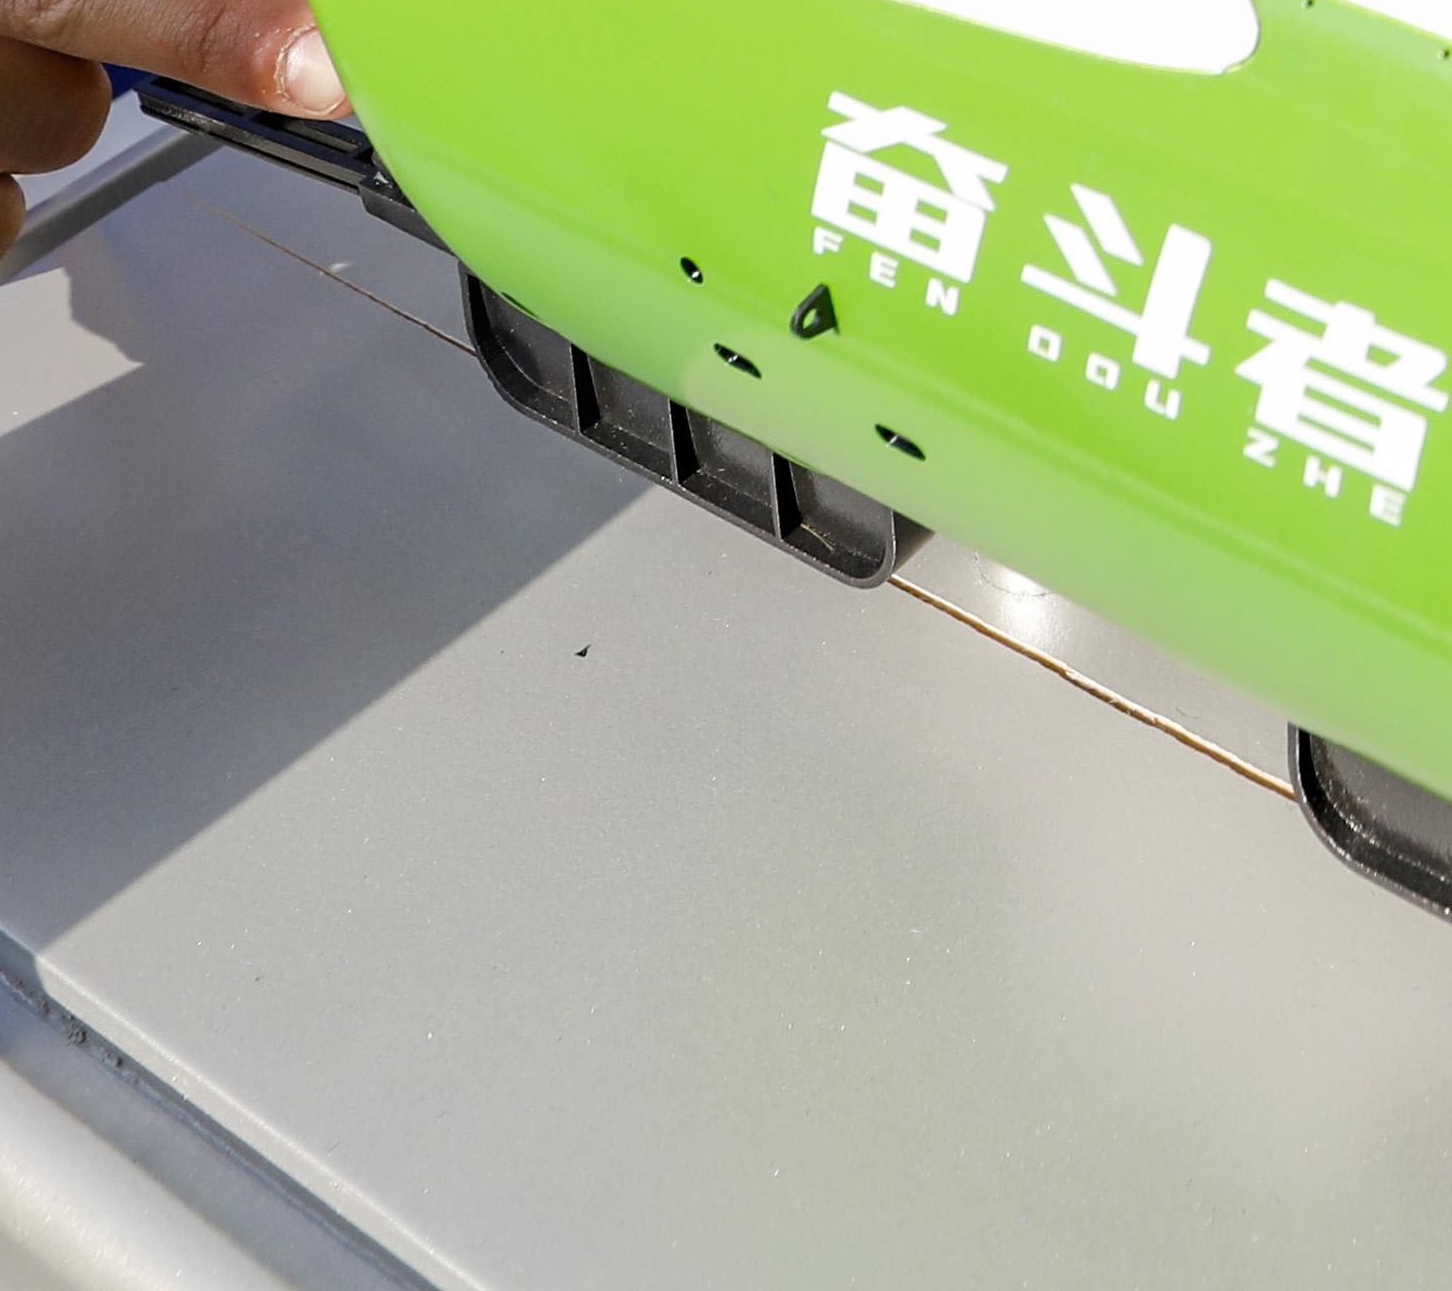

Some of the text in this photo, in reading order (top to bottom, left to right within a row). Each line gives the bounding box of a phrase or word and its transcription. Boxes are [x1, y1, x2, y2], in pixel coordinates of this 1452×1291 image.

[810, 90, 1450, 492] 奋斗者
[812, 225, 1409, 528] FEN DOU ZHE
